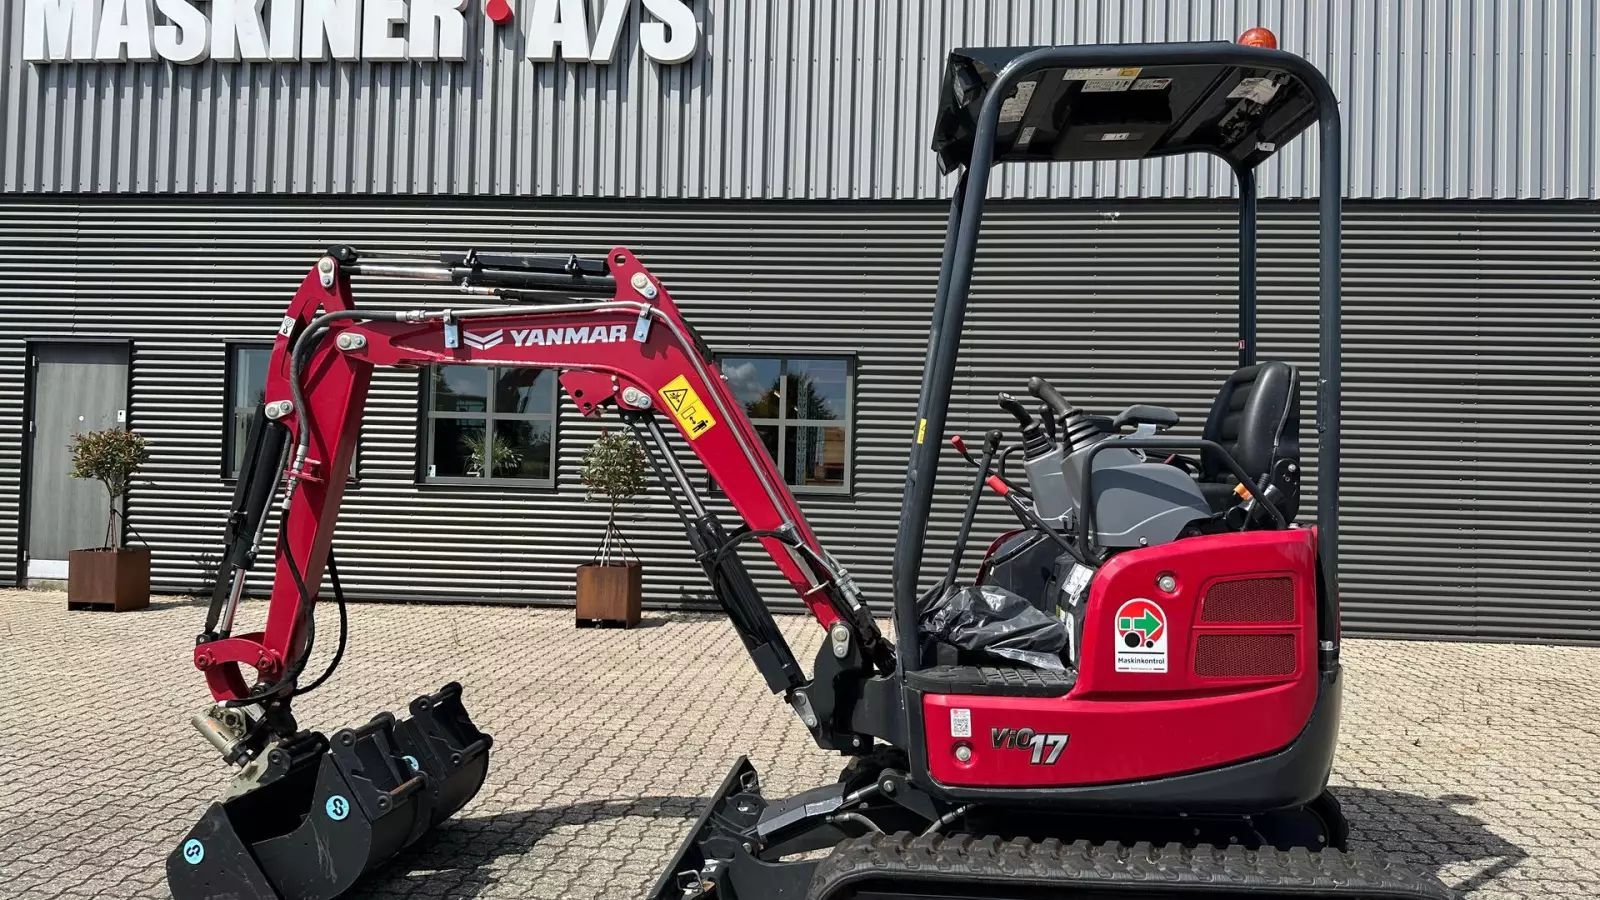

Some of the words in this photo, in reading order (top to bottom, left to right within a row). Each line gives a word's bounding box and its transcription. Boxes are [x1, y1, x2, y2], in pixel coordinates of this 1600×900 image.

[23, 0, 468, 63] MASKINER
[527, 0, 698, 64] A/S
[510, 325, 628, 347] YANMAR
[1117, 656, 1165, 665] Maskinkontrol
